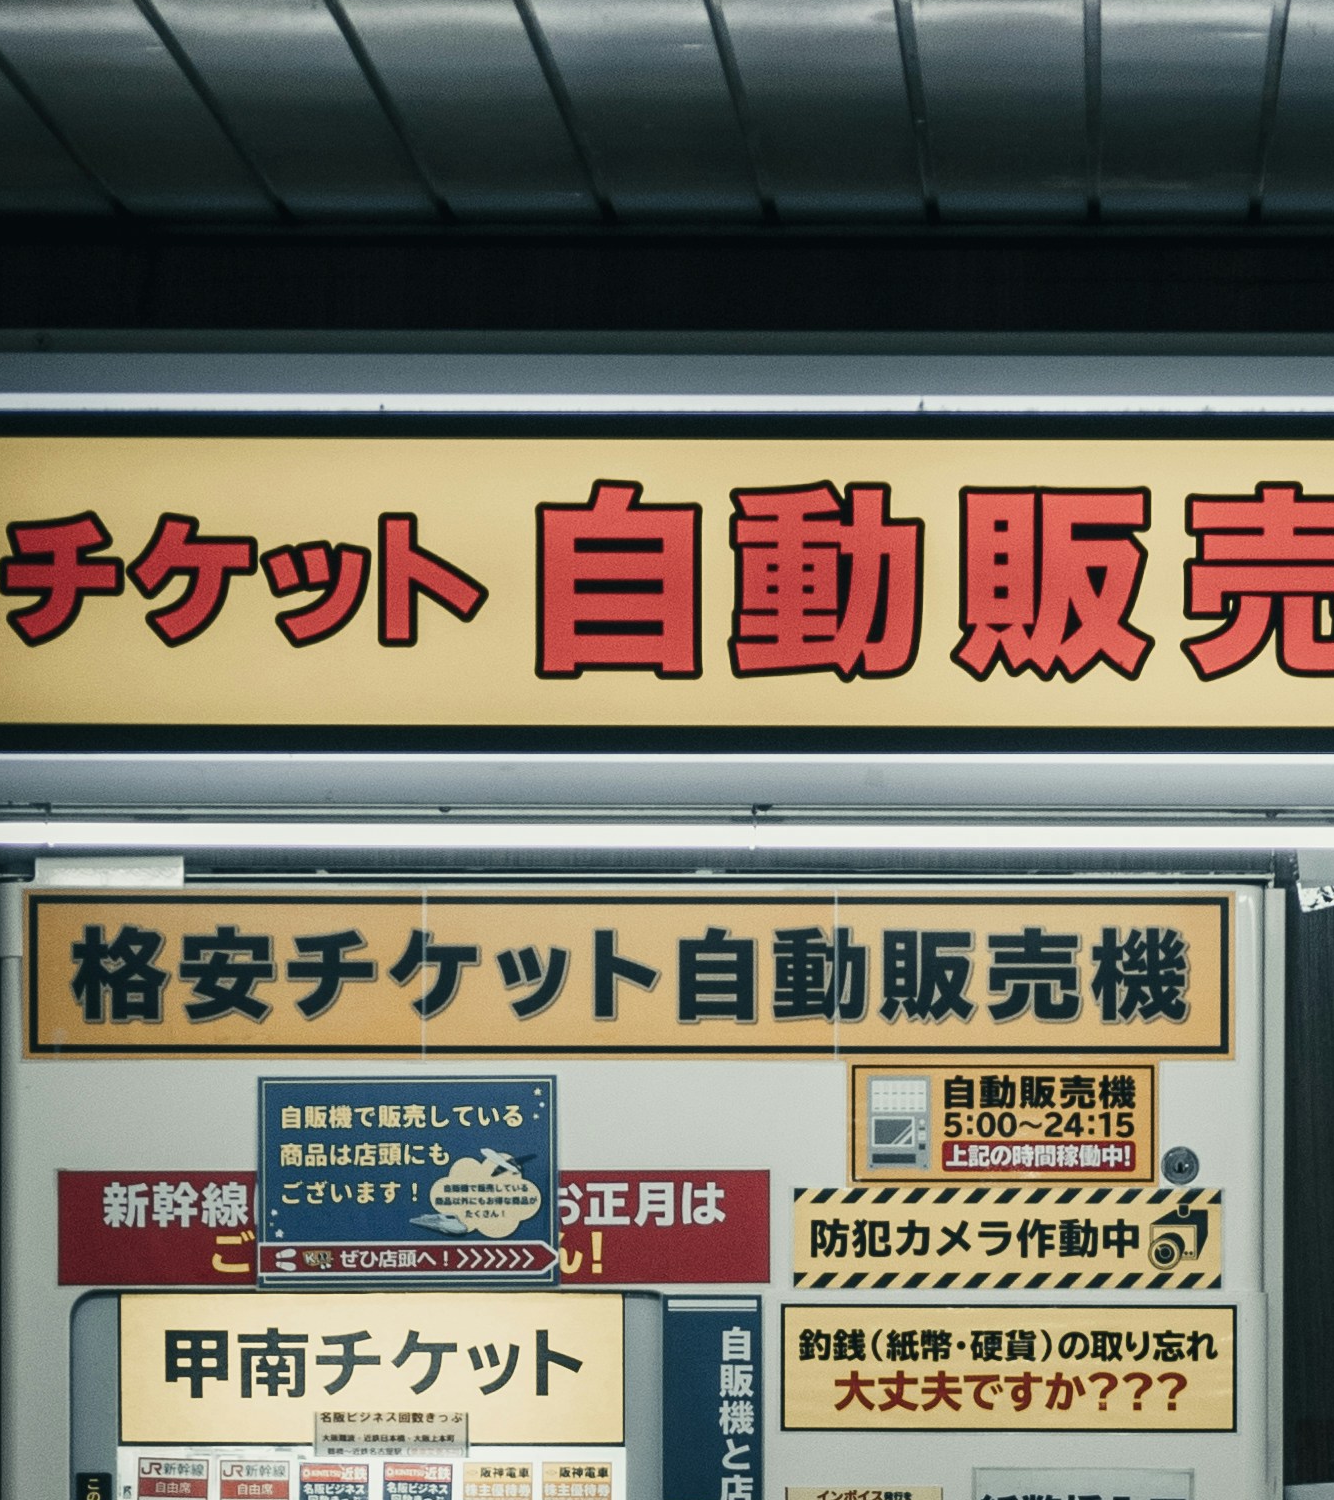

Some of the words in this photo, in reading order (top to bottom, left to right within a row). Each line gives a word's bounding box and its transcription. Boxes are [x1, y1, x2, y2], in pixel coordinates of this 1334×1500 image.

[67, 924, 1193, 1027] 格安チケット自動販売機
[944, 1075, 1136, 1109] 自動販売機
[280, 1105, 523, 1129] 自販機で販売している
[280, 1143, 450, 1167] 商品は店頭にも
[946, 1144, 1131, 1168] 上記の時間稼働中!
[282, 1181, 419, 1204] ございます！
[810, 1219, 1140, 1259] 防犯カメラ作動中
[340, 1250, 449, 1268] ぜひ店頭へ！
[799, 1329, 1218, 1363] 釣銭（紙幣・硬貨）の取り忘れ
[164, 1327, 583, 1398] 甲南チケット
[142, 1462, 204, 1477] JR新幹線
[223, 1464, 286, 1478] JR新幹線
[480, 1467, 529, 1478] 阪神電車
[559, 1467, 609, 1477] 阪神電車
[155, 1482, 191, 1494] 自由席
[237, 1484, 273, 1495] 自由席
[303, 1484, 365, 1495] 名阪ビジネス
